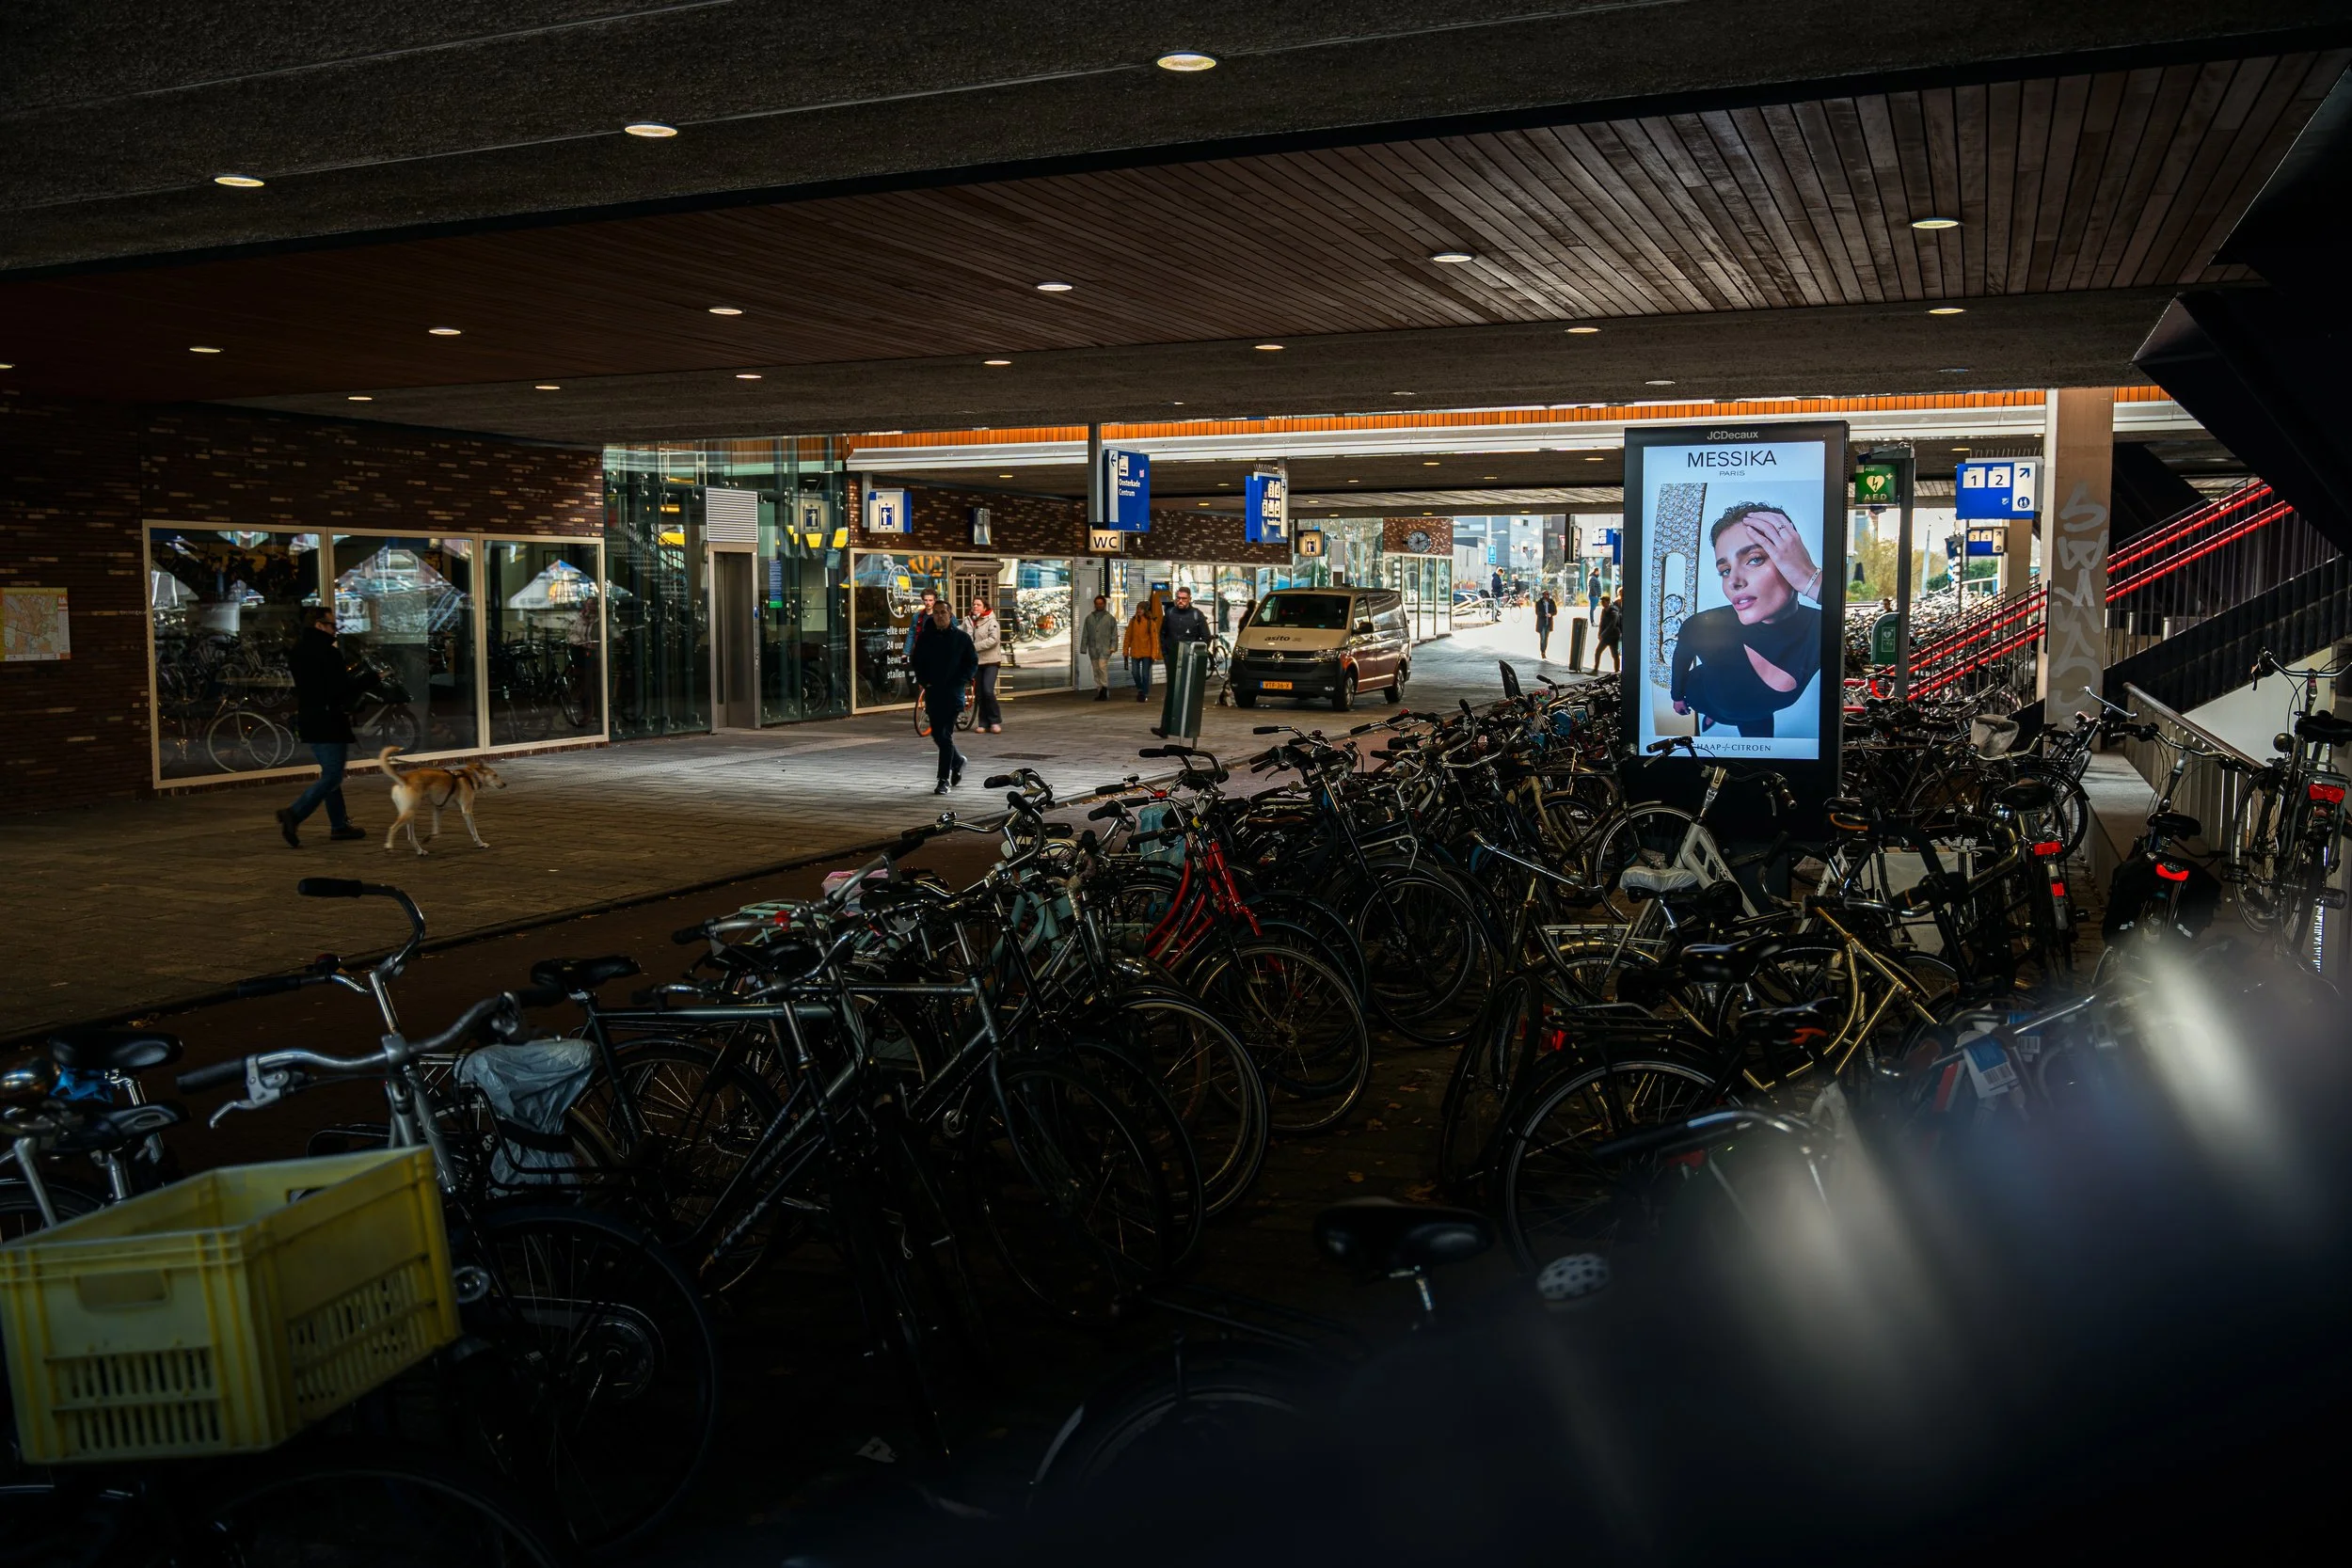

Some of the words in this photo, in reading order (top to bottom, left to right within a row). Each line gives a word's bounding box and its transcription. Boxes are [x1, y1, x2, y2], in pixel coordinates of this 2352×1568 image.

[1707, 431, 1758, 440] JCDecaux
[1687, 450, 1777, 467] MESSIKA
[1118, 478, 1141, 488] Oosterkade
[1971, 474, 1977, 486] 1
[1995, 474, 2003, 486] 2
[1118, 488, 1136, 498] Centrum
[1093, 536, 1118, 548] WC
[886, 626, 898, 636] elke
[886, 641, 894, 650] 24
[887, 669, 905, 679] stallen
